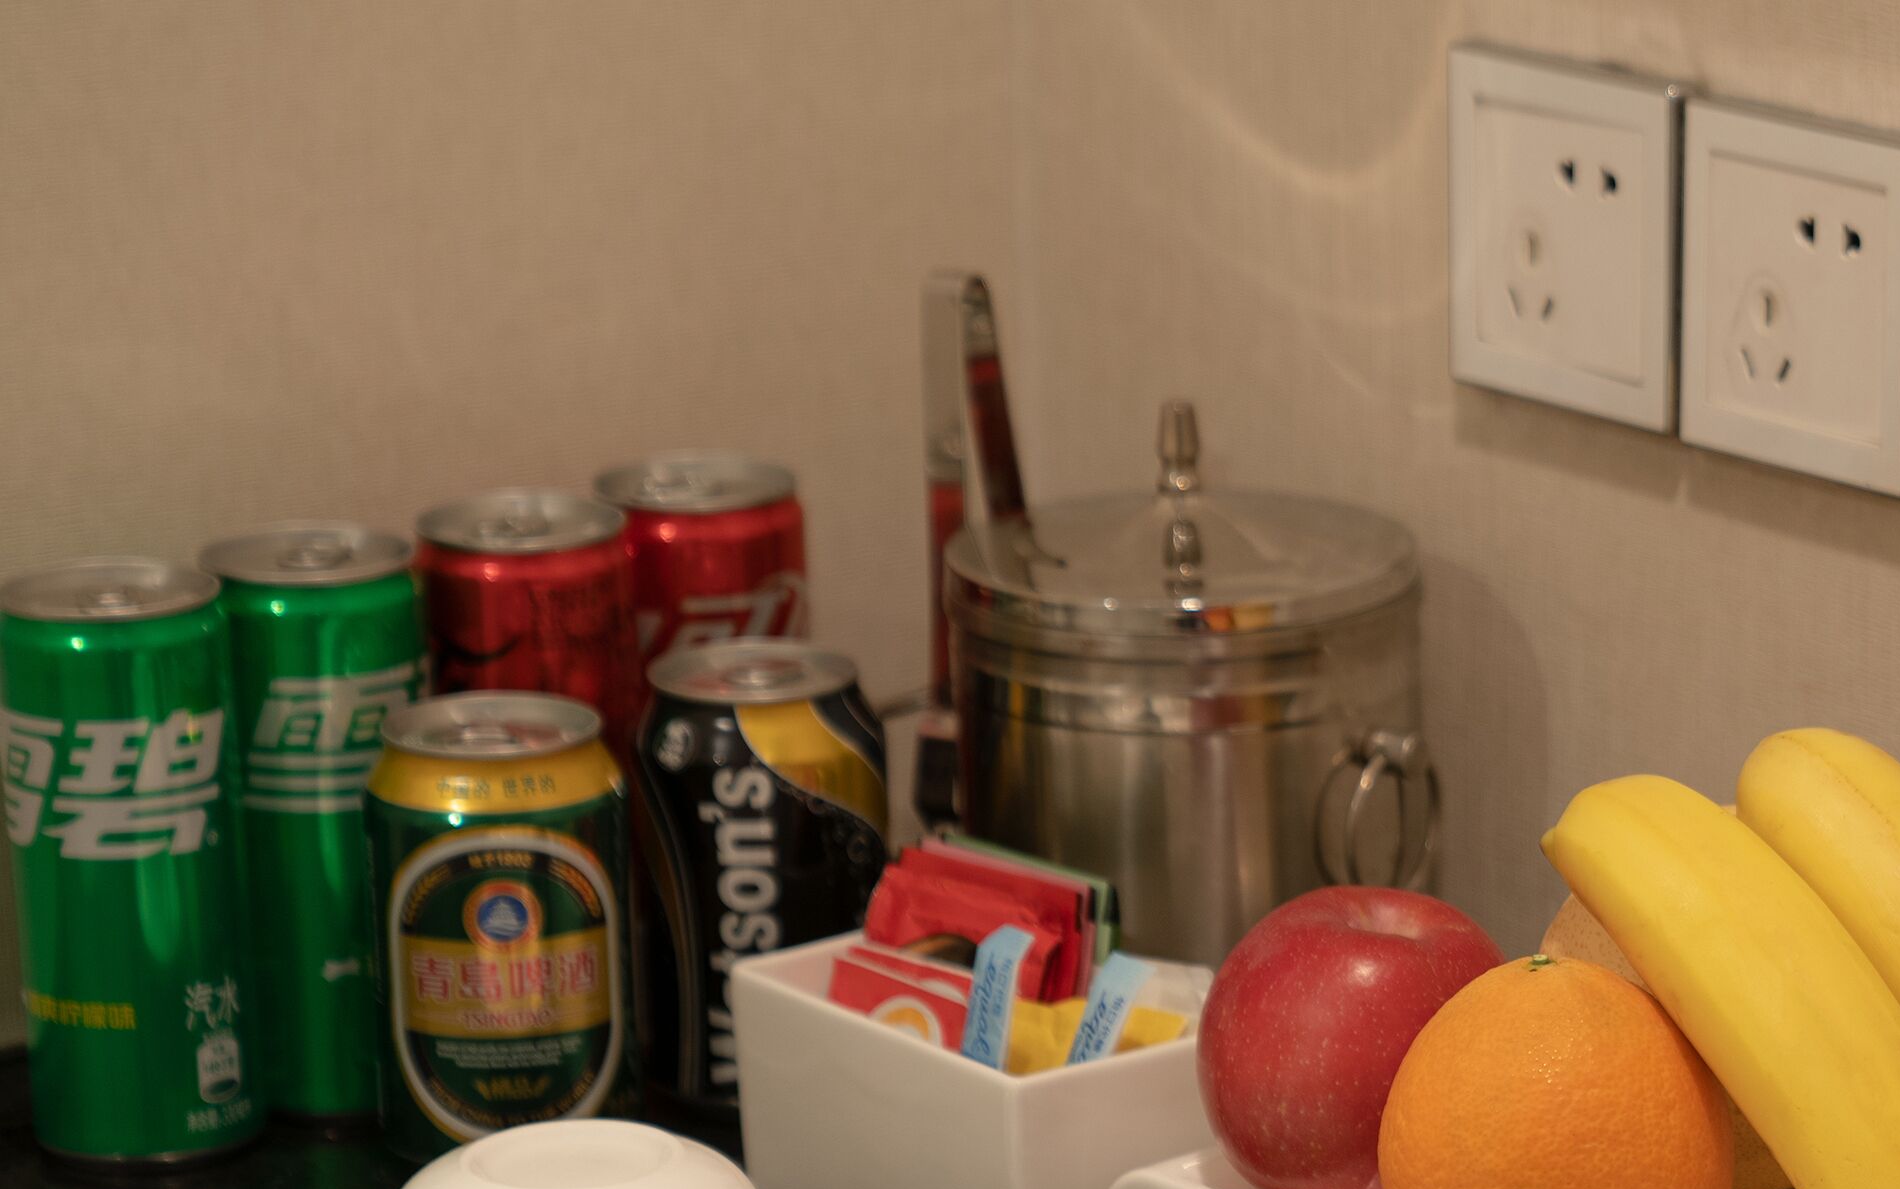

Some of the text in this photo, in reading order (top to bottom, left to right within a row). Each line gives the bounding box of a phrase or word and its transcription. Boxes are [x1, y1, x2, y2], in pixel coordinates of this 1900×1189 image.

[502, 774, 556, 796] 世界的
[699, 765, 781, 1085] son's
[186, 975, 240, 1031] 汽水
